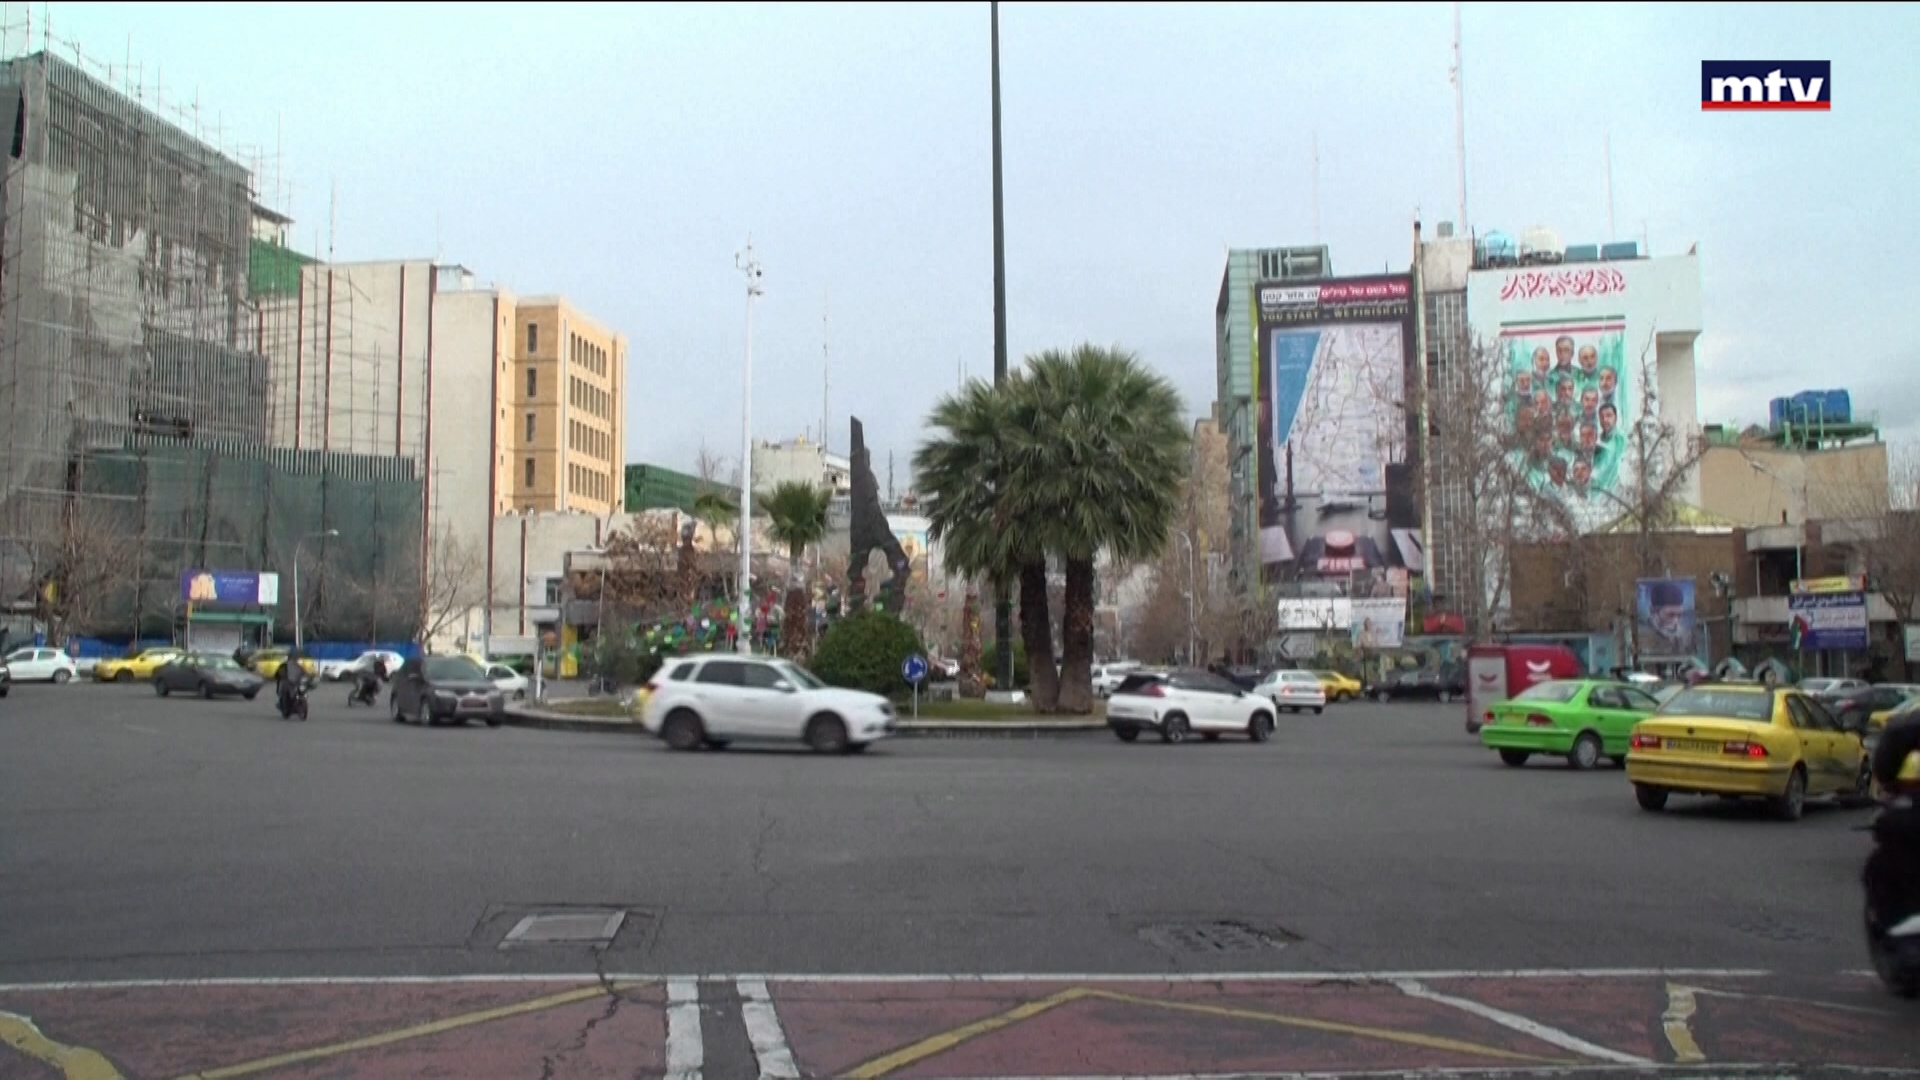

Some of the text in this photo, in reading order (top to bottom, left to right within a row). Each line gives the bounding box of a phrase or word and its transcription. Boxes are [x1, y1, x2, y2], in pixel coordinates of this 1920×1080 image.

[1262, 312, 1283, 322] YOU
[1286, 310, 1319, 321] START
[1334, 308, 1349, 319] WE
[1353, 306, 1390, 317] FINISH
